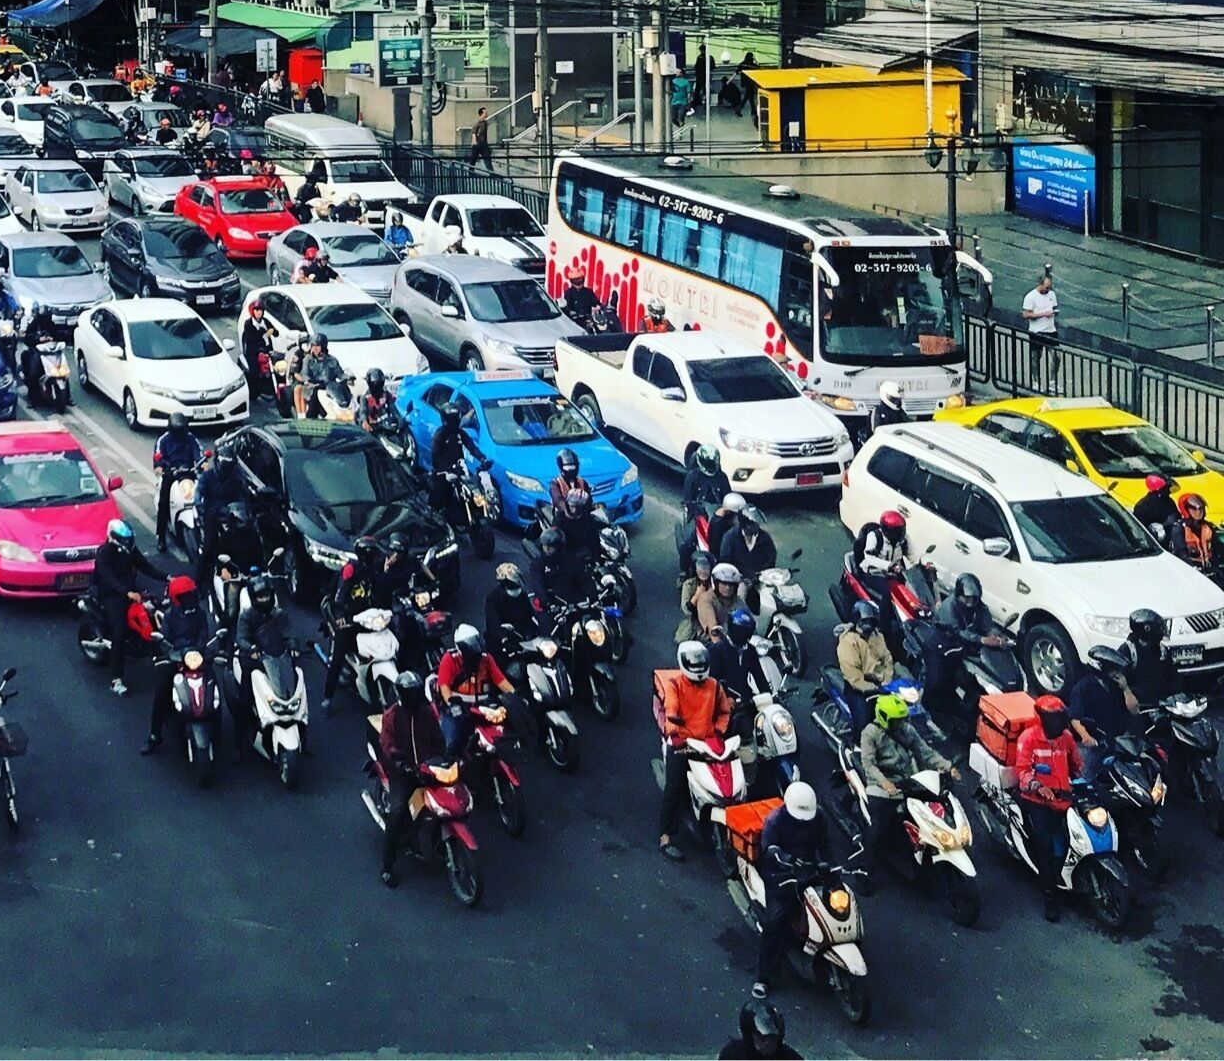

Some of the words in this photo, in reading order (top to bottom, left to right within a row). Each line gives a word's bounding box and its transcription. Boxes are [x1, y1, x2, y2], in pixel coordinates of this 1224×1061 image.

[1063, 157, 1072, 168] 24
[659, 194, 725, 225] 02-517-9203-6
[854, 263, 932, 273] 02-517-9203-6
[642, 269, 719, 319] MONTRI
